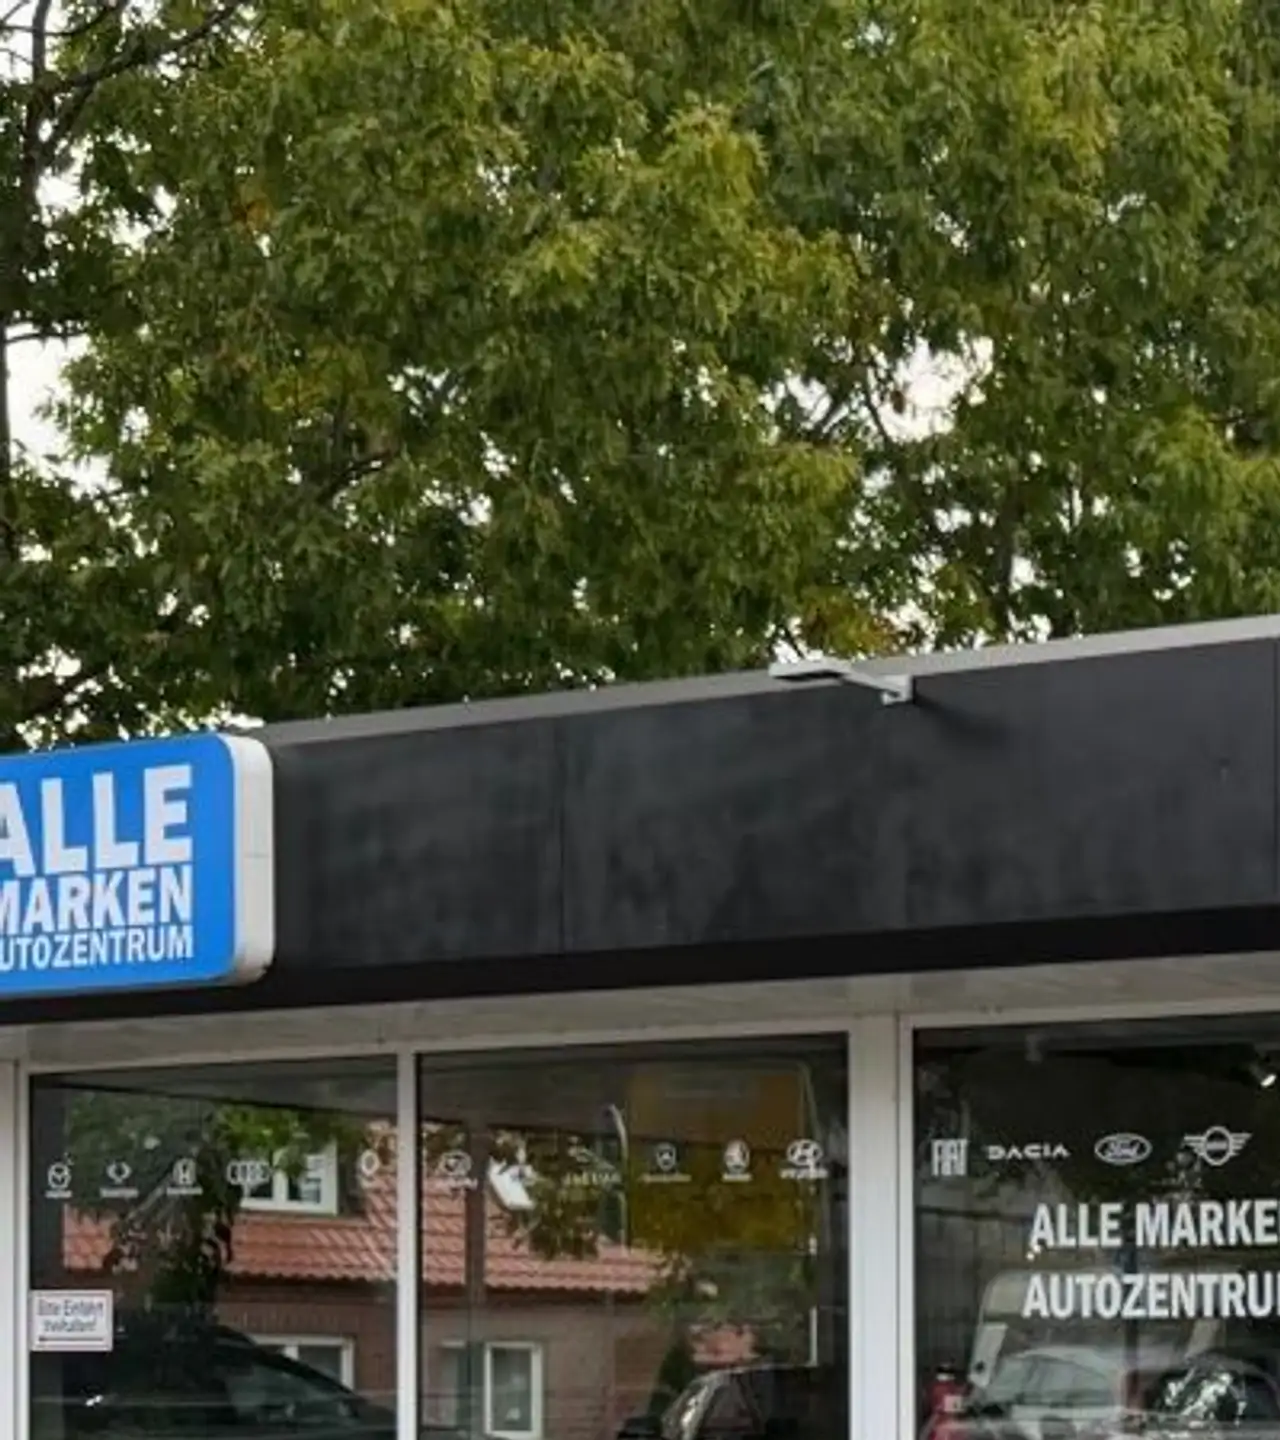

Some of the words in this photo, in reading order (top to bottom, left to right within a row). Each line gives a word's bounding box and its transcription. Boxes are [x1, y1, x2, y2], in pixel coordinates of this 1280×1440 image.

[0, 764, 193, 877] ALLE
[0, 925, 195, 971] UTOZENTRUM
[987, 1143, 1070, 1160] DACIA
[1031, 1201, 1123, 1248] ALLE
